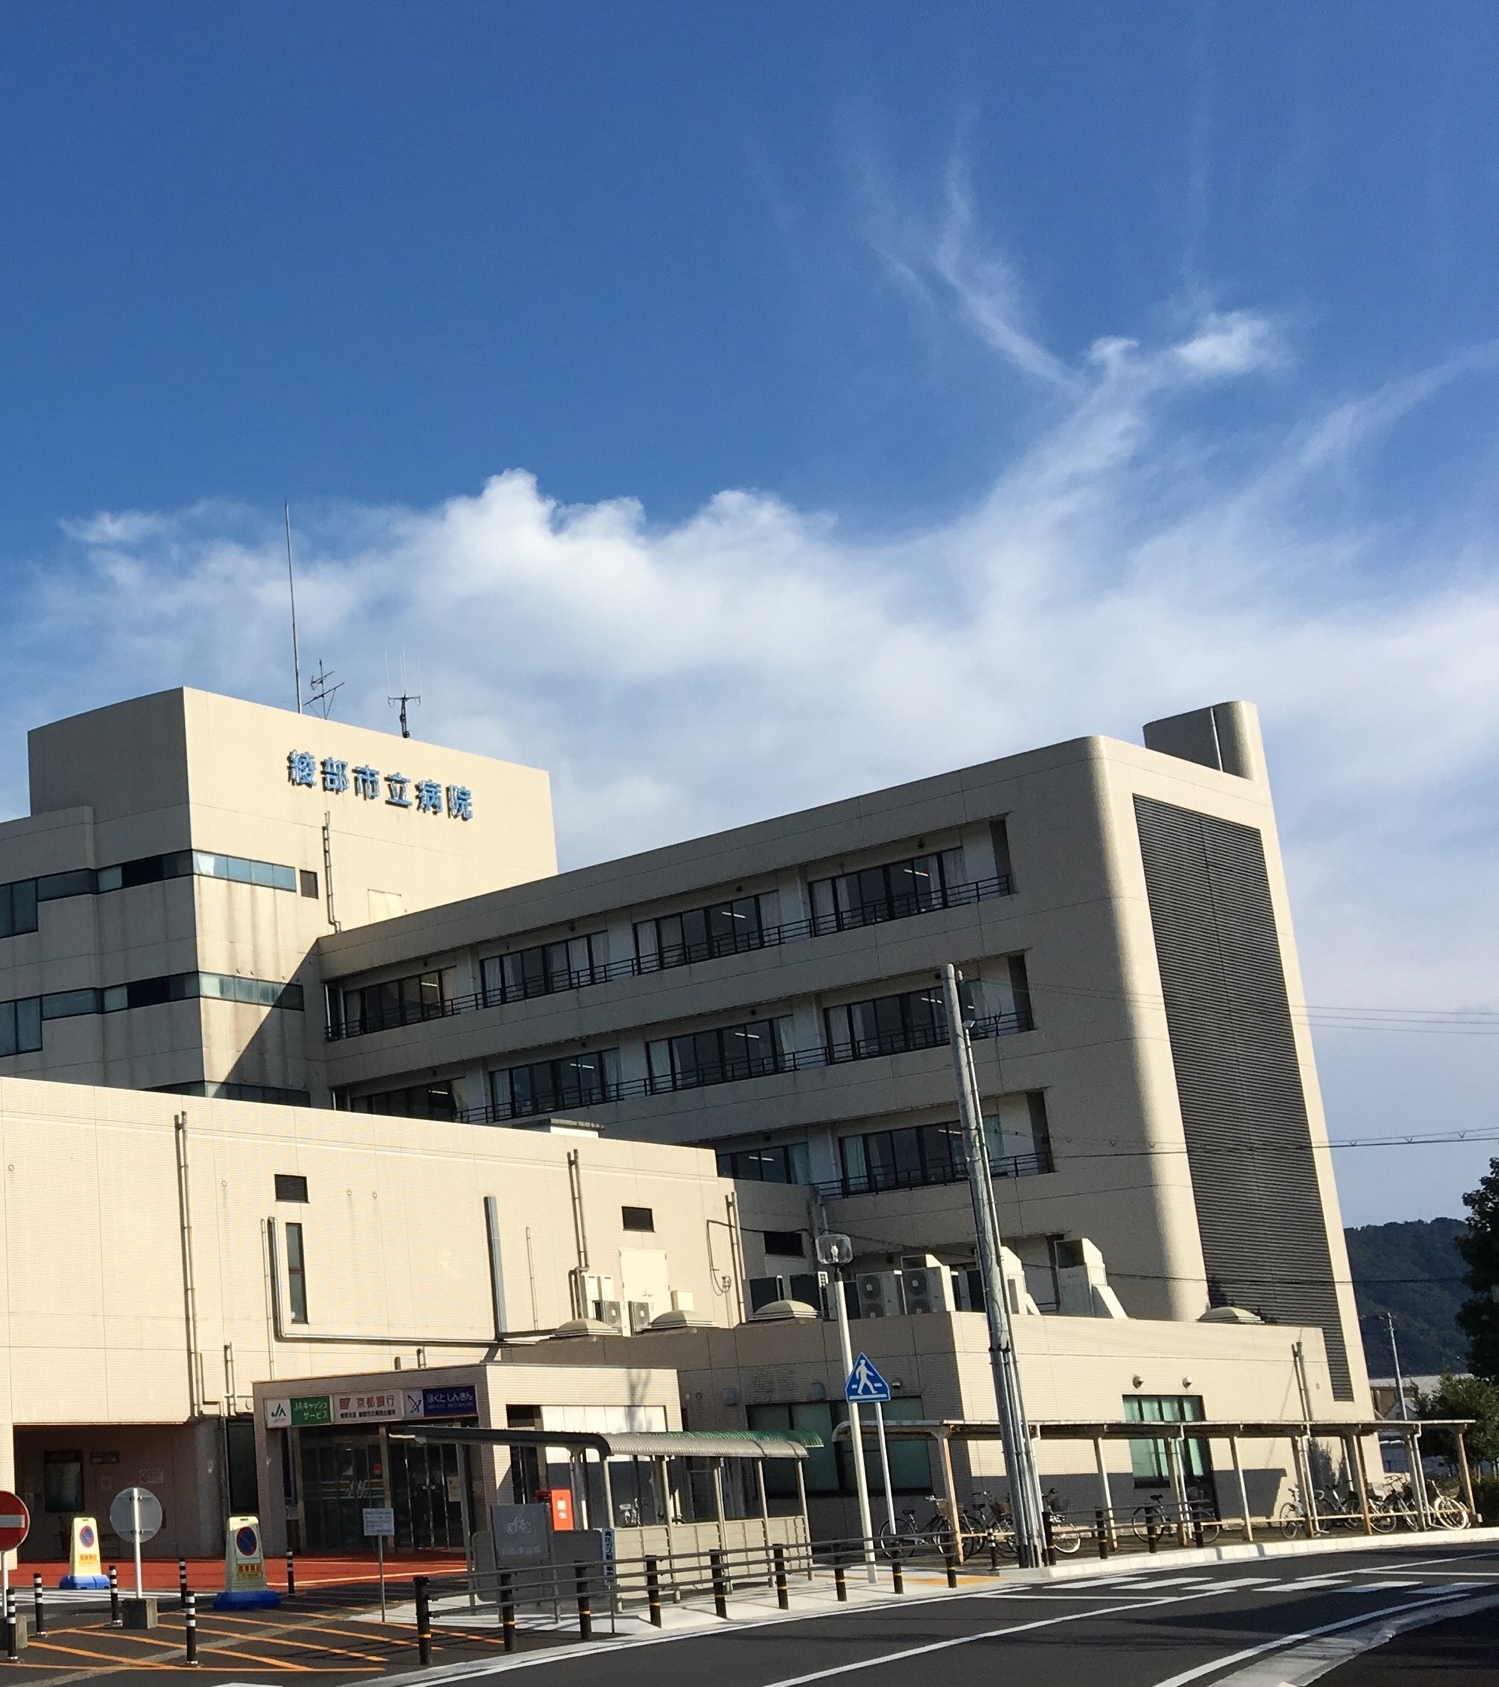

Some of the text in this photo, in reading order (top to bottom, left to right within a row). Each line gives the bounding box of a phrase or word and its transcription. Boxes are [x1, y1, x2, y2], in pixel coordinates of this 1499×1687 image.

[287, 749, 473, 821] 綾部市立病院
